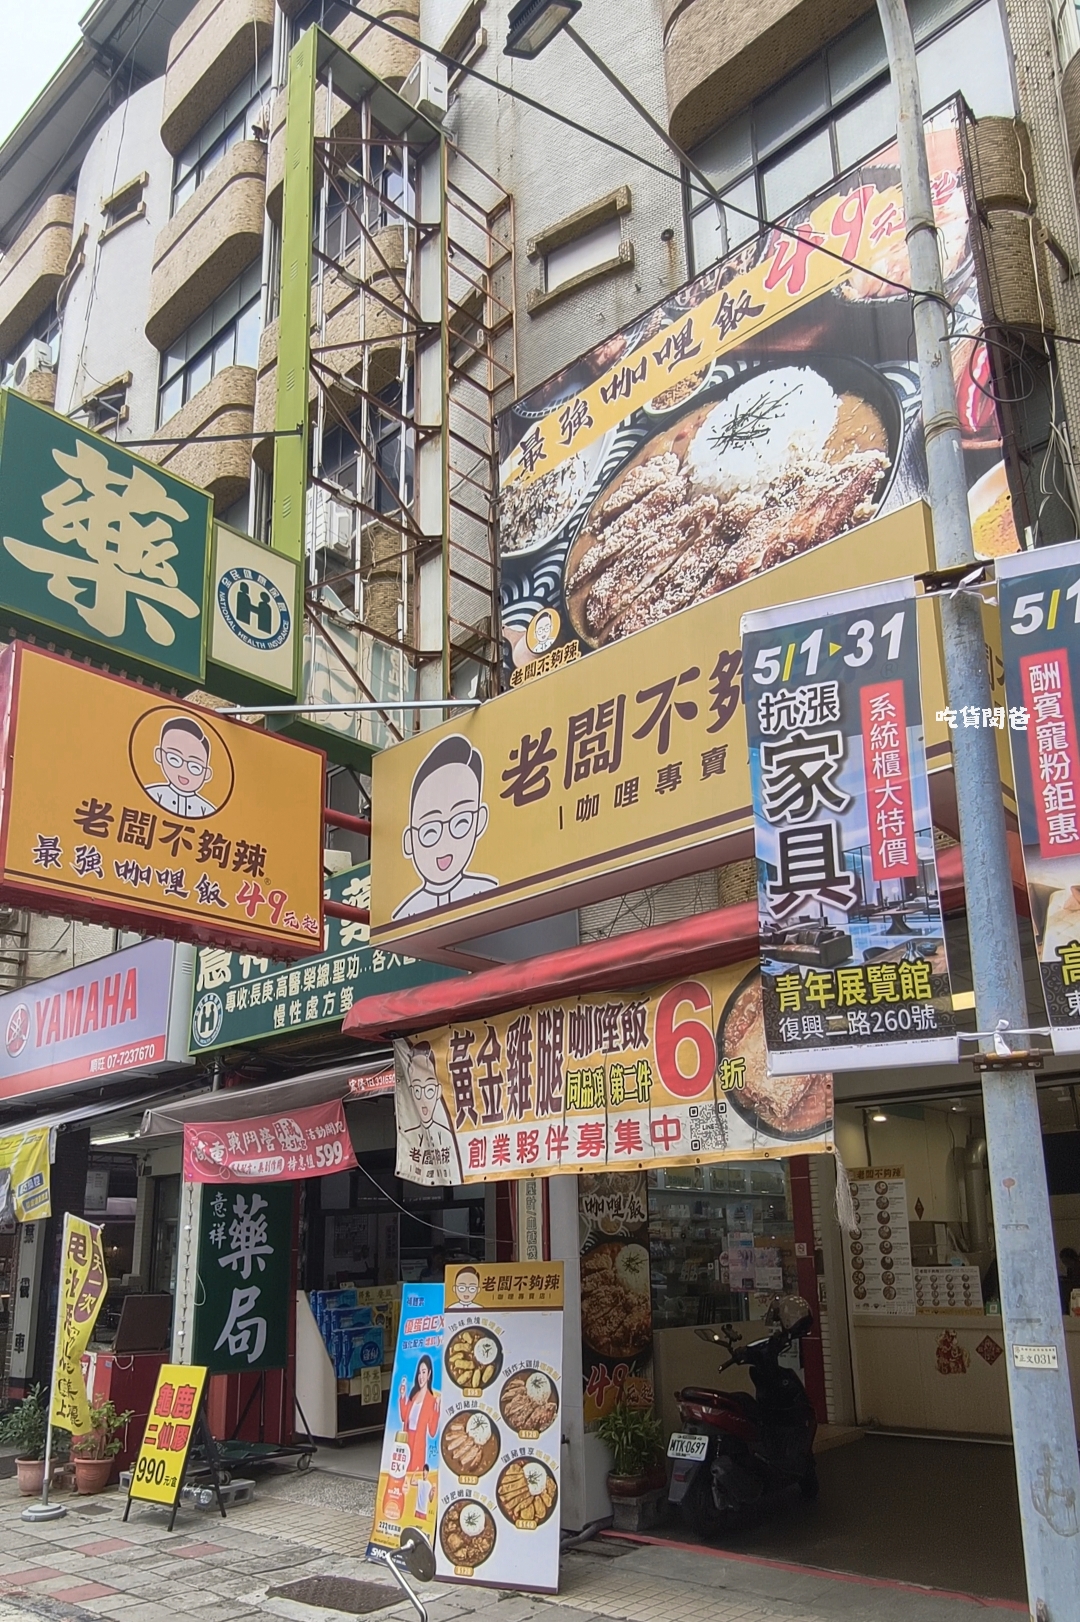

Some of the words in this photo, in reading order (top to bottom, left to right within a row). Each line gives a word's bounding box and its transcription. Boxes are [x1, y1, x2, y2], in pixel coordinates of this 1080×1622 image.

[518, 289, 764, 477] 最強咖哩飯
[3, 438, 200, 646] 藥
[219, 591, 237, 630] NATIONAL
[237, 630, 266, 649] HEALTH
[510, 641, 581, 687] 老闆不夠辣
[758, 682, 840, 733] 抗漲
[868, 692, 910, 869] 系統櫃大特價
[1028, 660, 1080, 846] 酬賓寵粉鉅惠
[72, 796, 270, 879] 老闆不夠辣
[31, 833, 230, 909] 最強咖哩飯
[35, 967, 139, 1048] YAMAHA
[775, 961, 933, 1014] 青年展覽館
[778, 1003, 938, 1042] 復興二路260號
[106, 1043, 155, 1069] 07-7237670
[449, 997, 650, 1131] 黃金雞腿咖哩飯
[610, 1059, 652, 1105] 第二件
[468, 1114, 682, 1170] 創業夥伴募集中
[209, 1191, 228, 1249] 意祥
[584, 1194, 646, 1223] 咖哩飯
[213, 1193, 275, 1364] 藥局
[482, 1274, 560, 1292] 老闆不夠辣
[144, 1421, 191, 1452] 二仙膠
[669, 1439, 706, 1455] MTK-0697
